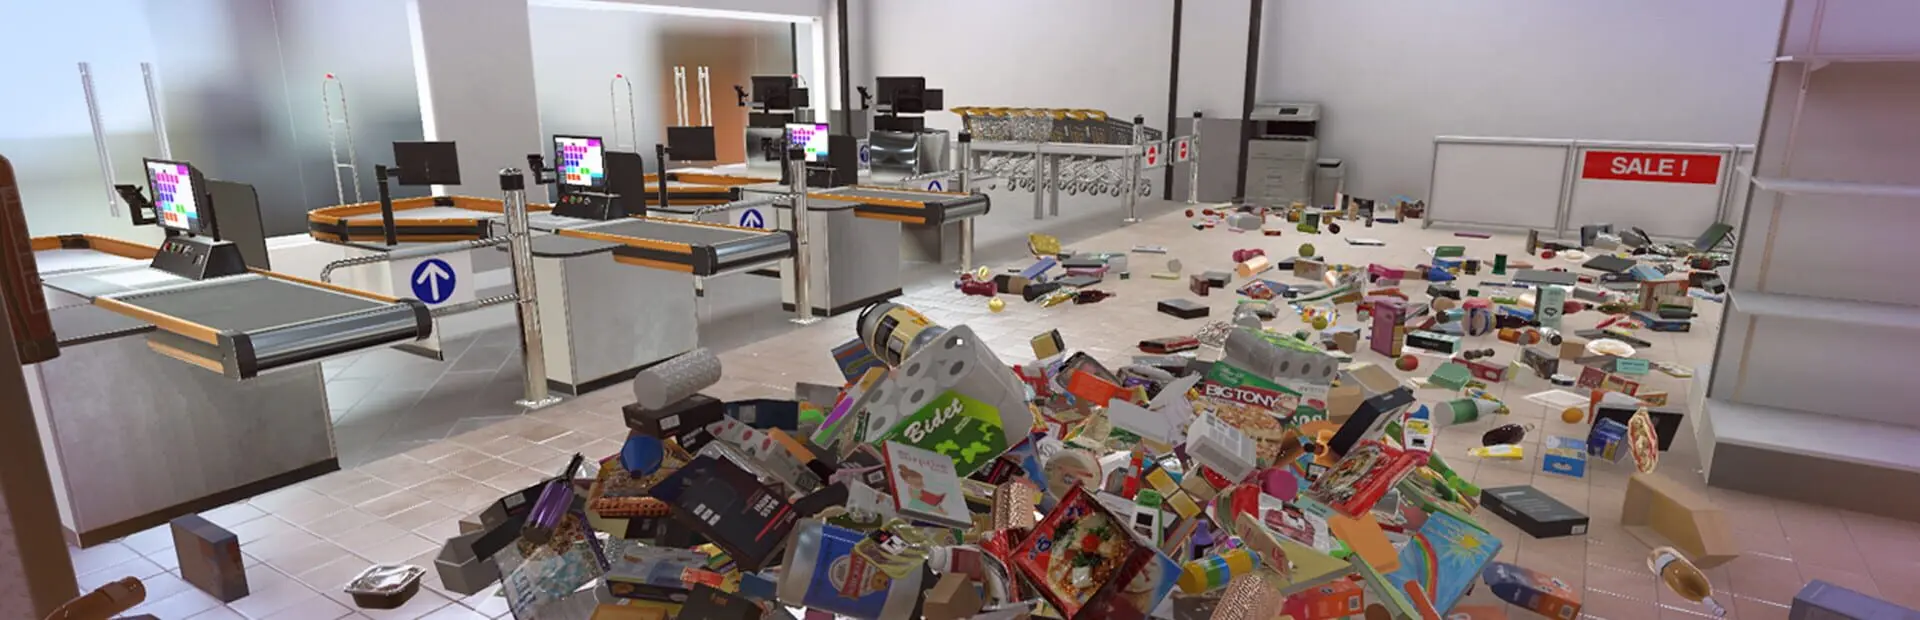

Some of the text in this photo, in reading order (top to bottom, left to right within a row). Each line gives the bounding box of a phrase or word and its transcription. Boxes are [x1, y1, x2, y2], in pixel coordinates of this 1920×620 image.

[1610, 156, 1689, 176] SALE !
[903, 398, 963, 444] Bidet
